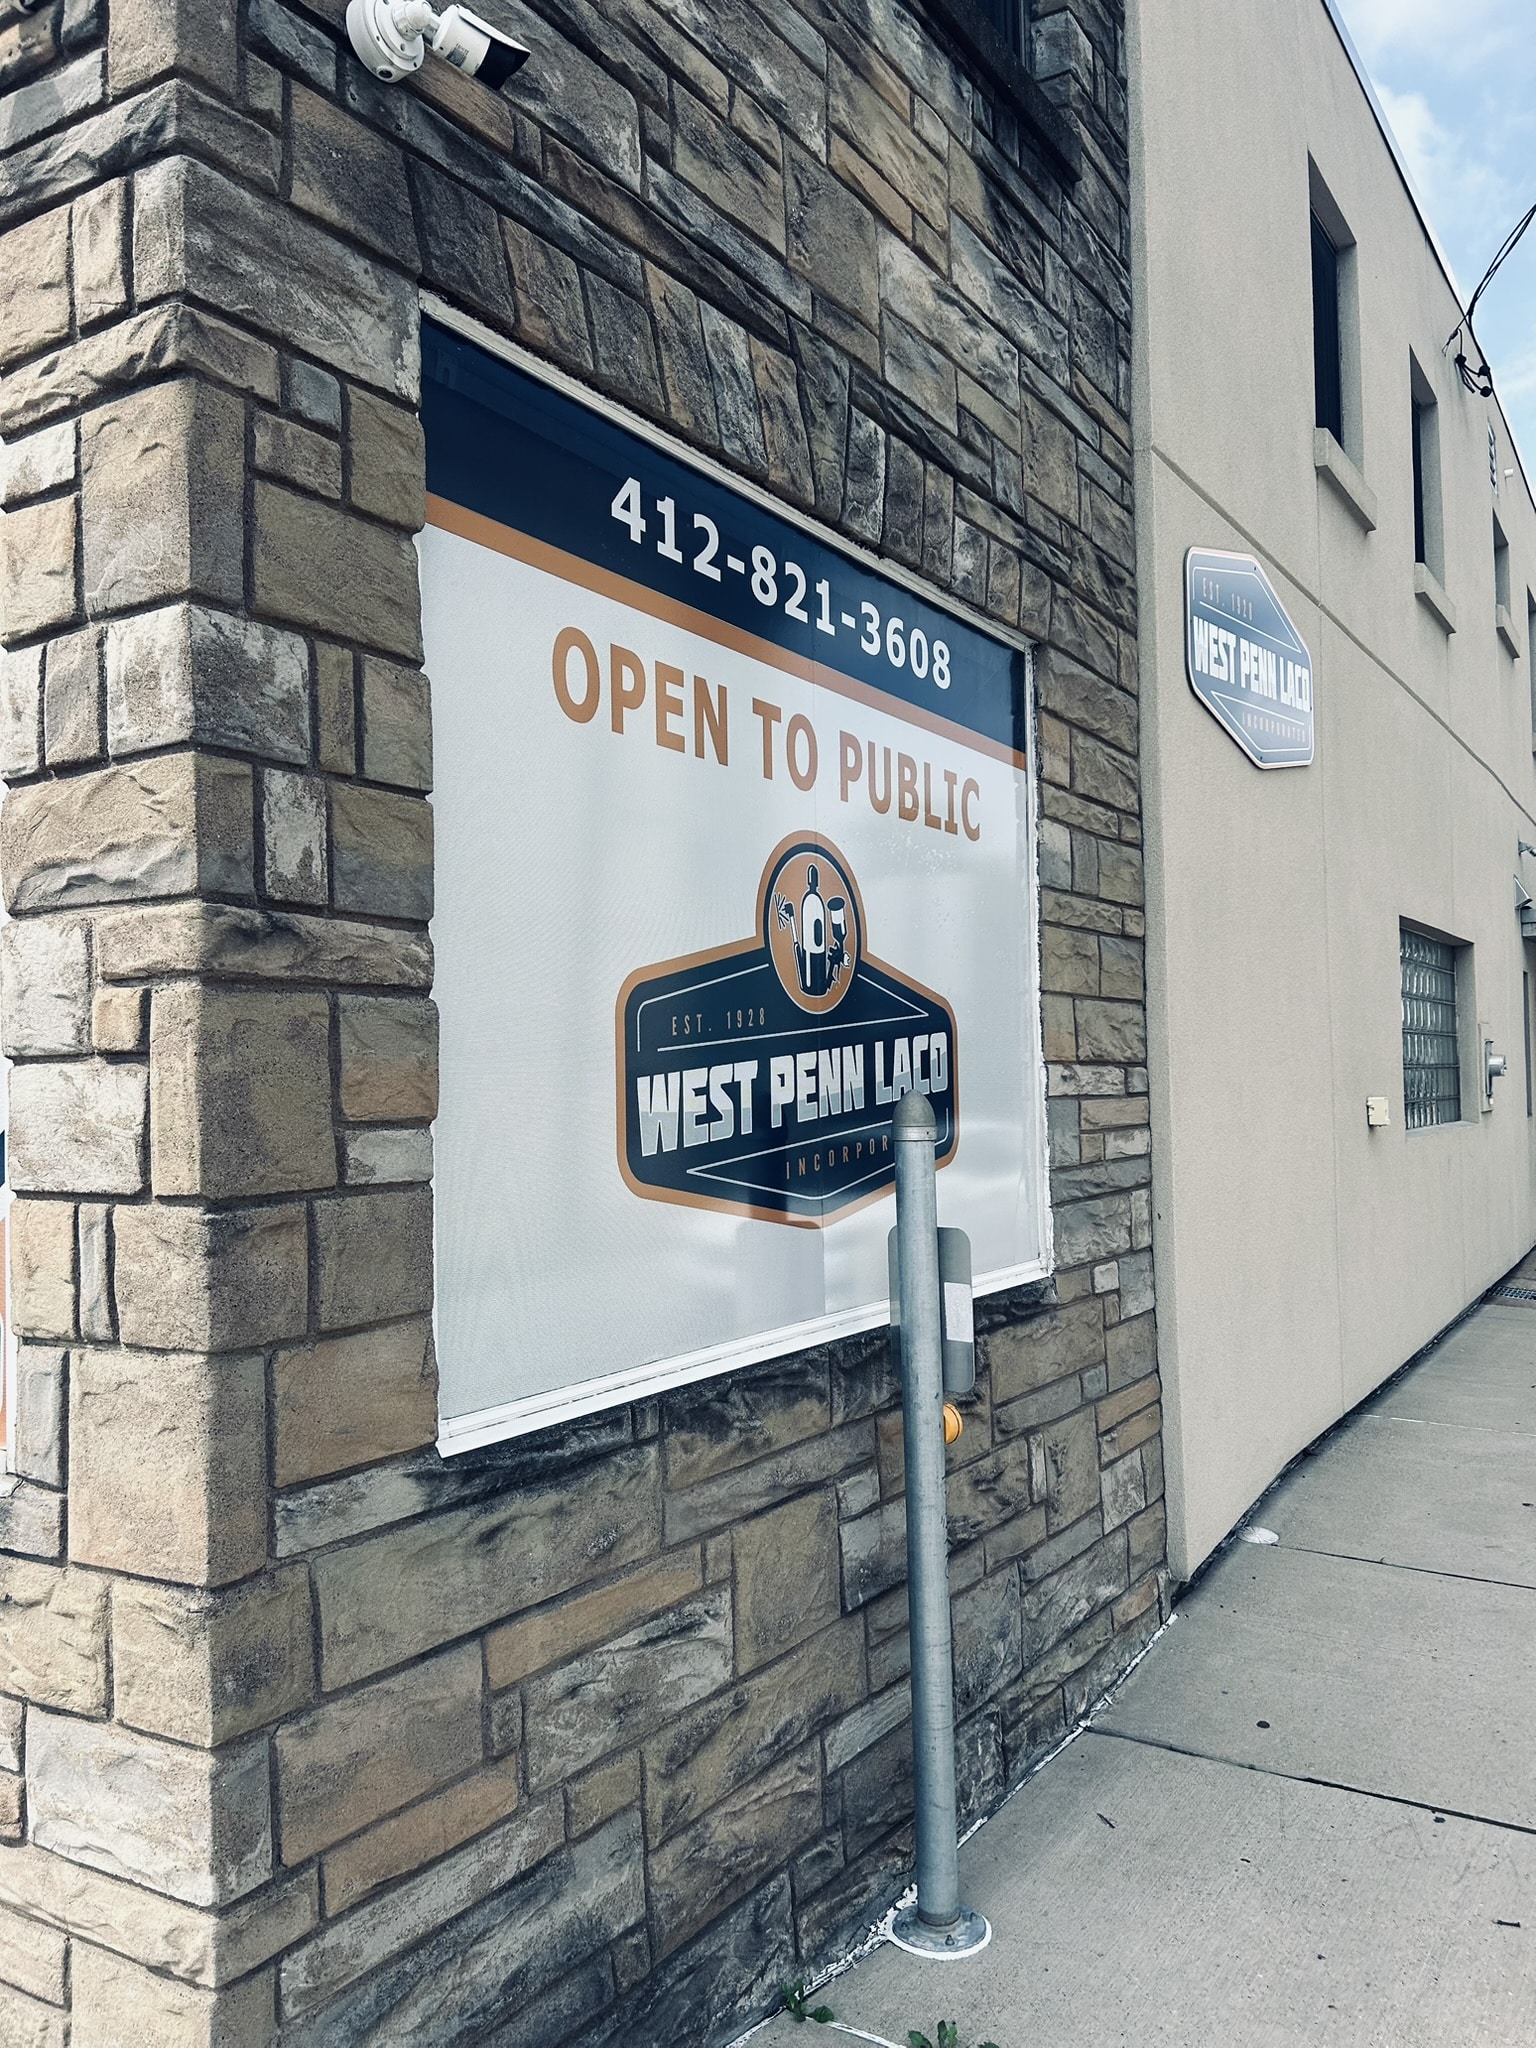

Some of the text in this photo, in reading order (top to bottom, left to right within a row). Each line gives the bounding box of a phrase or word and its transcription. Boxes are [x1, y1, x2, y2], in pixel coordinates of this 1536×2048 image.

[611, 476, 952, 690] 412-821-3608
[1193, 615, 1311, 713] WEST PENN LACO
[552, 626, 981, 842] OPEN TO PUBLIC
[672, 1008, 765, 1036] EST. 1928
[636, 1031, 949, 1157] WEST PENN LACO
[786, 1134, 889, 1180] INCORPOR
